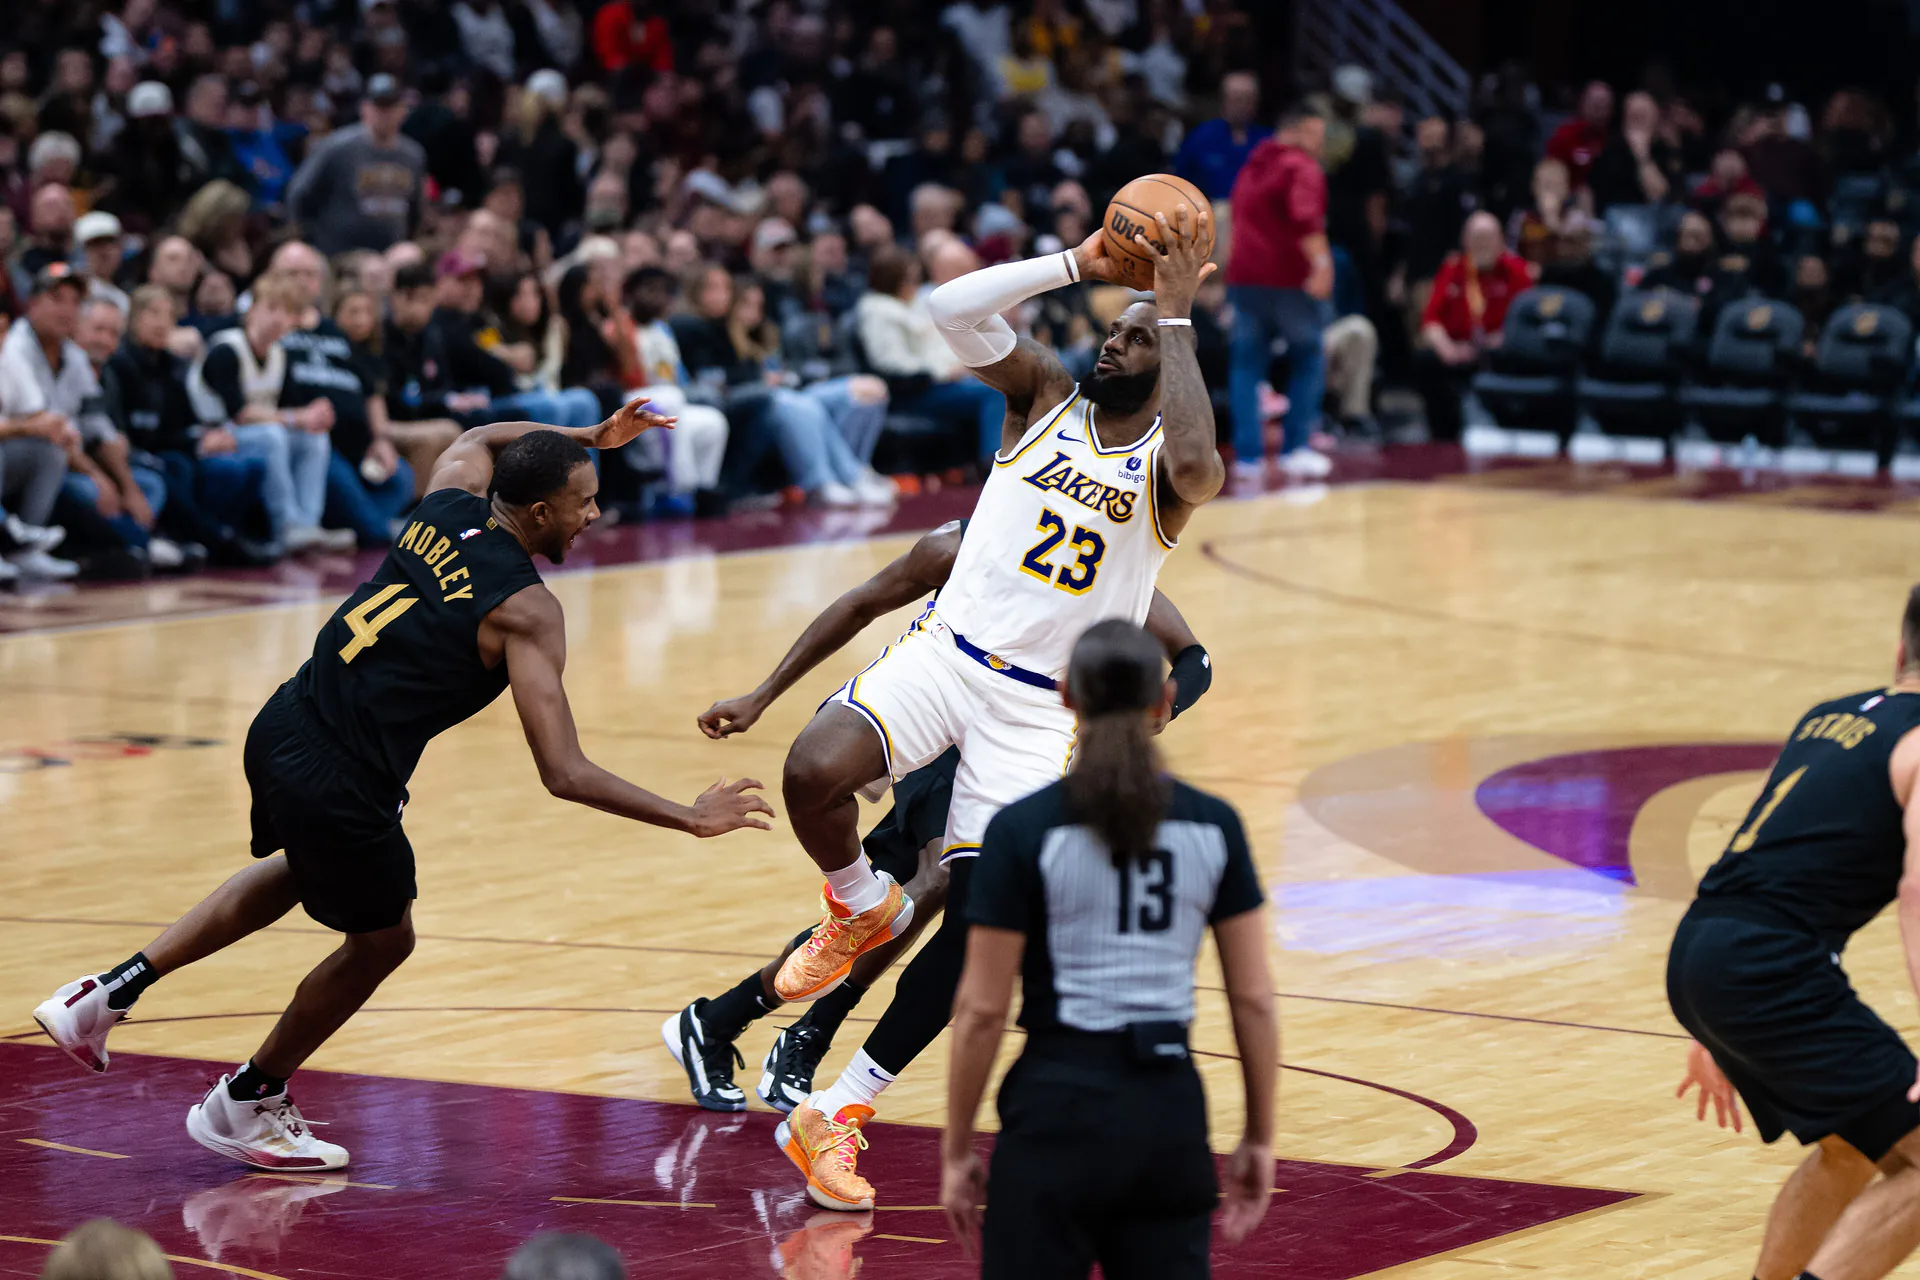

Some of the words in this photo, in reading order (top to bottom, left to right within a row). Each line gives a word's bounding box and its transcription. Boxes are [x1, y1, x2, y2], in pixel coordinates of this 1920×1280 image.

[1021, 450, 1138, 524] LAKERS
[1117, 470, 1146, 484] bibigo
[398, 521, 474, 603] MOBLEY
[1018, 506, 1108, 597] 23
[338, 583, 420, 664] 4
[1731, 764, 1809, 853] 1
[1112, 850, 1174, 935] 13
